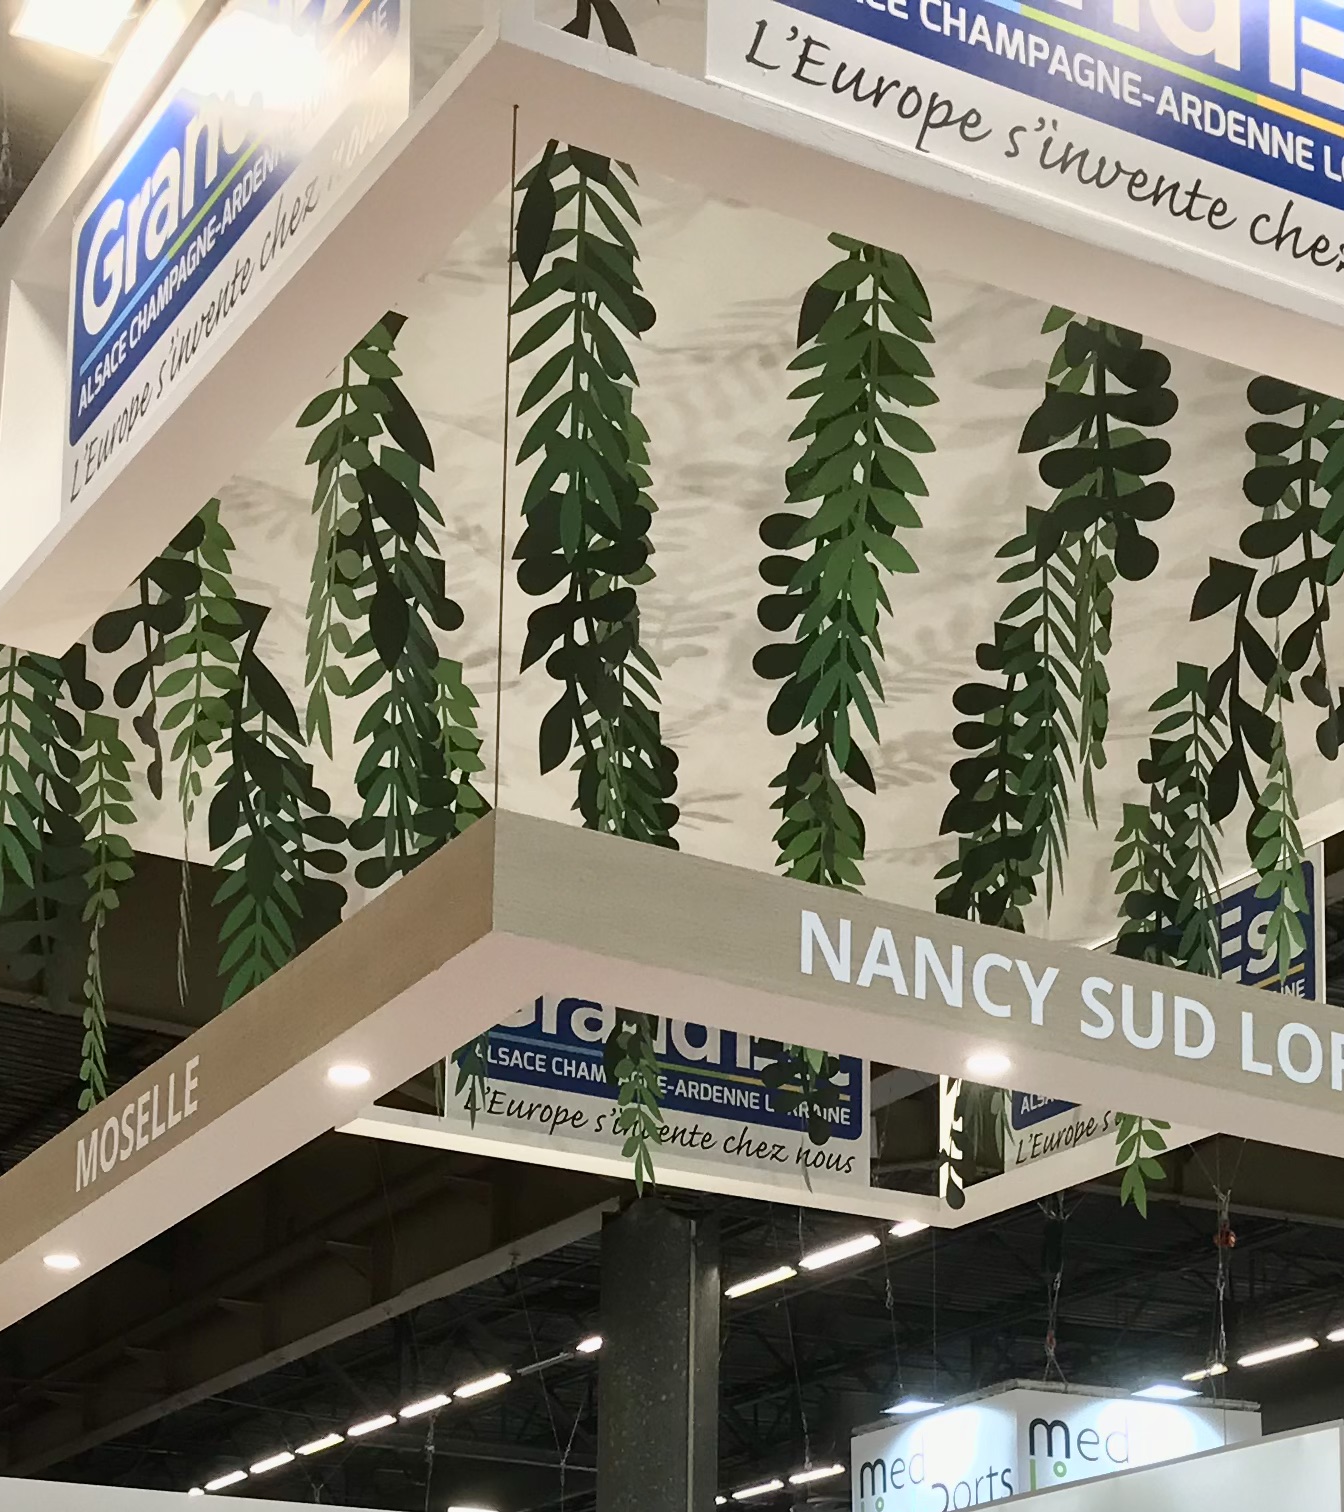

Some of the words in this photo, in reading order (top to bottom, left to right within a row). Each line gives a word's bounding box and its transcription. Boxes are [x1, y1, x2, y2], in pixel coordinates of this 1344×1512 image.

[745, 18, 992, 153] L'Europe
[1006, 118, 1236, 231] s'invente
[919, 0, 1315, 172] CHAMPAGNE-ARDENNE
[70, 380, 152, 504] L'Europe
[77, 340, 127, 418] ALSACE
[800, 910, 1060, 1027] NANCY
[1080, 977, 1216, 1061] SUD
[75, 1054, 201, 1194] MOSELLE
[723, 1125, 789, 1165] chez
[796, 1145, 857, 1174] nous
[1016, 1117, 1098, 1165] L'Europe
